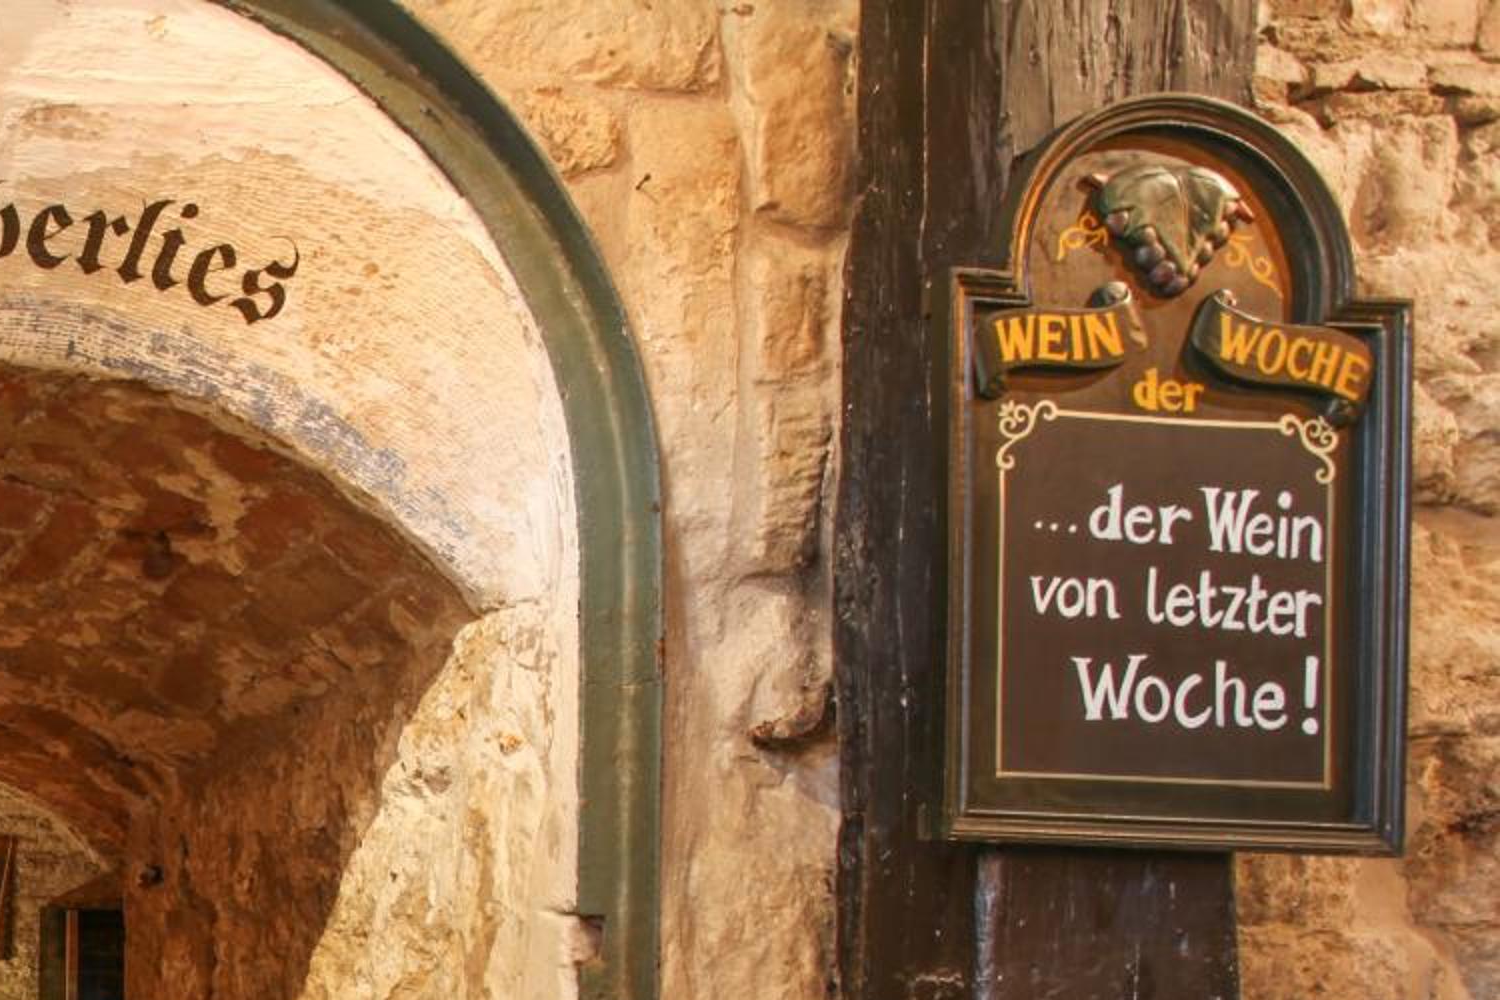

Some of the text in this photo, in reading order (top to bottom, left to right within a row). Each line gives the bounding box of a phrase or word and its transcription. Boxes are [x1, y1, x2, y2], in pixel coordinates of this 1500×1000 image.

[996, 312, 1124, 362] WEIN
[1219, 313, 1370, 400] WOCHE
[1133, 368, 1204, 413] der
[1200, 486, 1323, 562] Wein
[1030, 566, 1322, 637] von letzter
